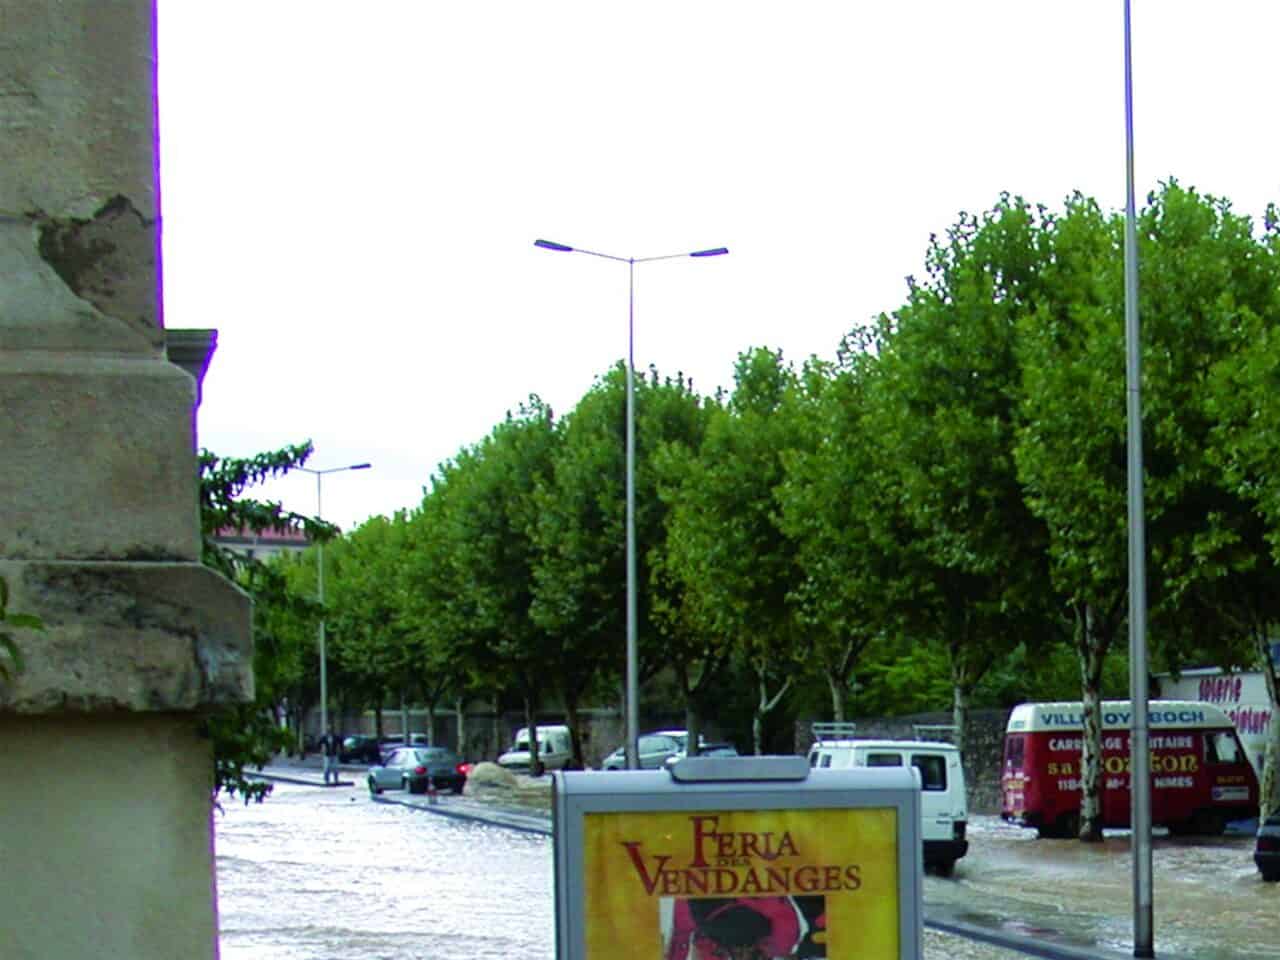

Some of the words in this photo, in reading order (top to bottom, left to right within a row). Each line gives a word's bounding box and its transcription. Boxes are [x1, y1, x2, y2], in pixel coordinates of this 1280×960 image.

[1041, 712, 1131, 725] VILLOY
[689, 815, 800, 868] FERIA
[620, 841, 862, 896] VENDANGES
